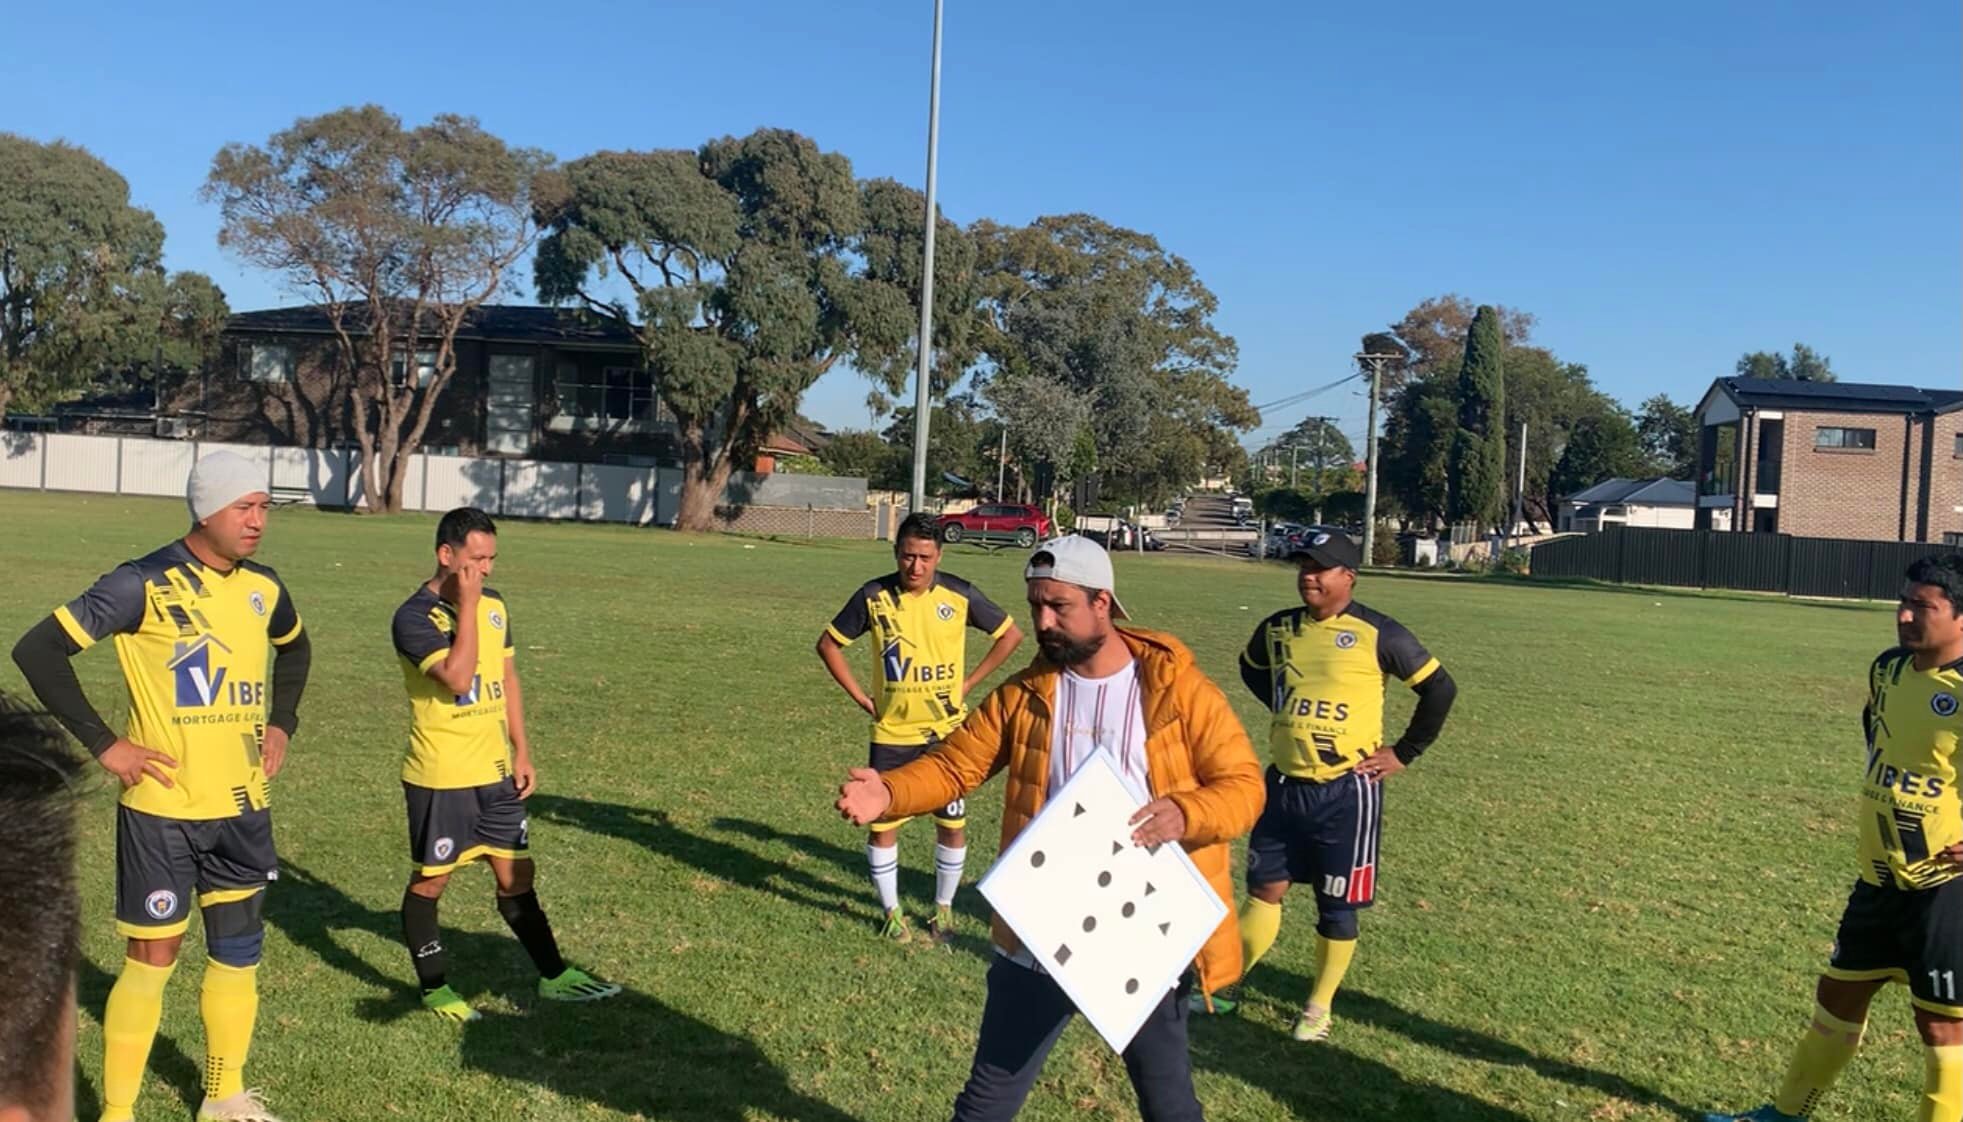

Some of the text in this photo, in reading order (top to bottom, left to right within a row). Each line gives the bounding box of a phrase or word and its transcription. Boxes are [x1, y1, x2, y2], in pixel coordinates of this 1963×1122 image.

[889, 655, 955, 682] VIBES
[1276, 686, 1349, 721] VIBES
[172, 713, 241, 725] MORTGAGE
[1322, 873, 1347, 898] 10
[1928, 969, 1955, 1000] 11
